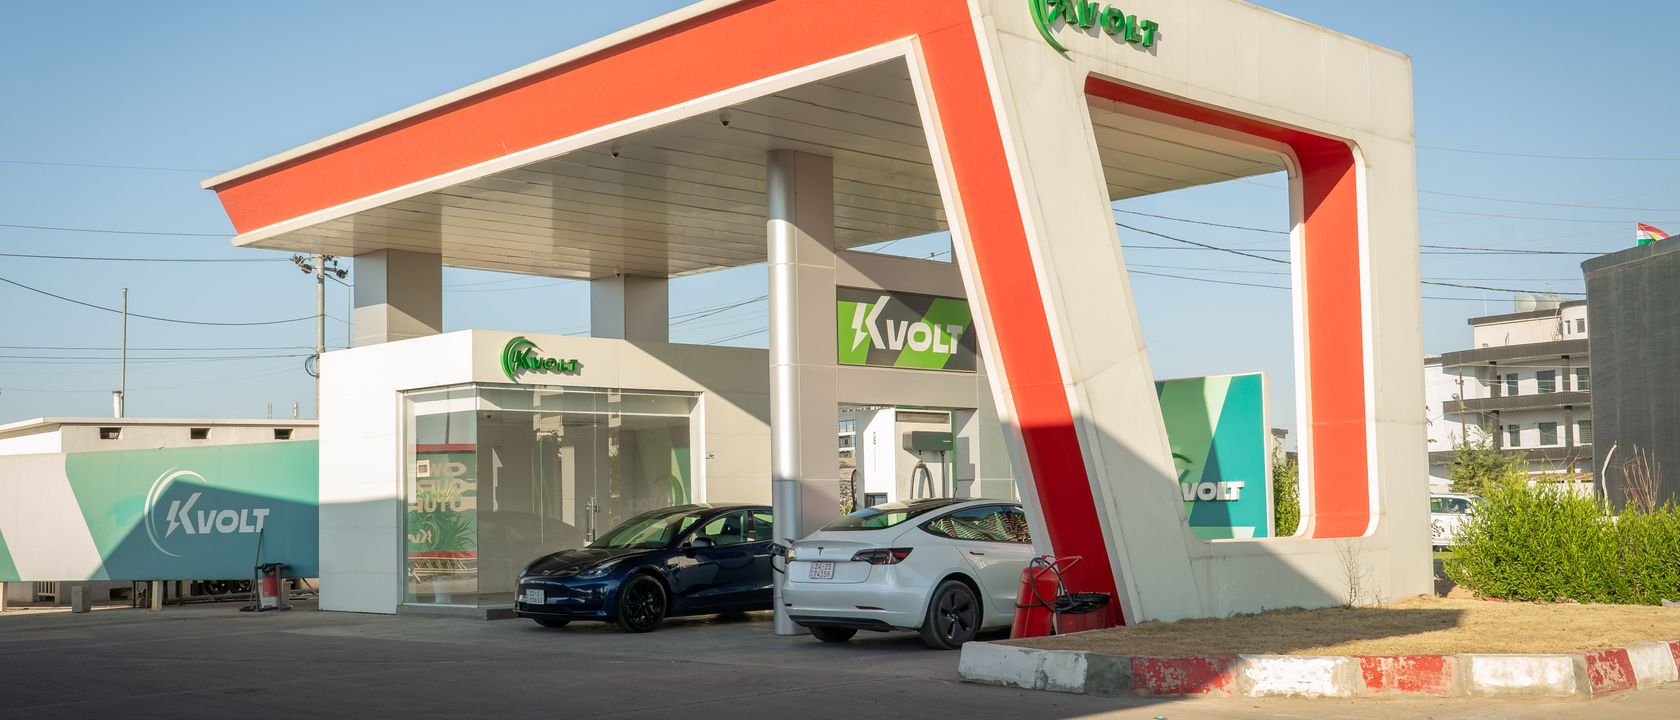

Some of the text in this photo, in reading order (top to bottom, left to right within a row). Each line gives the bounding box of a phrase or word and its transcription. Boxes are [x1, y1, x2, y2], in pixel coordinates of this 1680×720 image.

[851, 295, 963, 354] KVOLT
[513, 347, 578, 372] KVOLT
[165, 492, 270, 538] KVOLT
